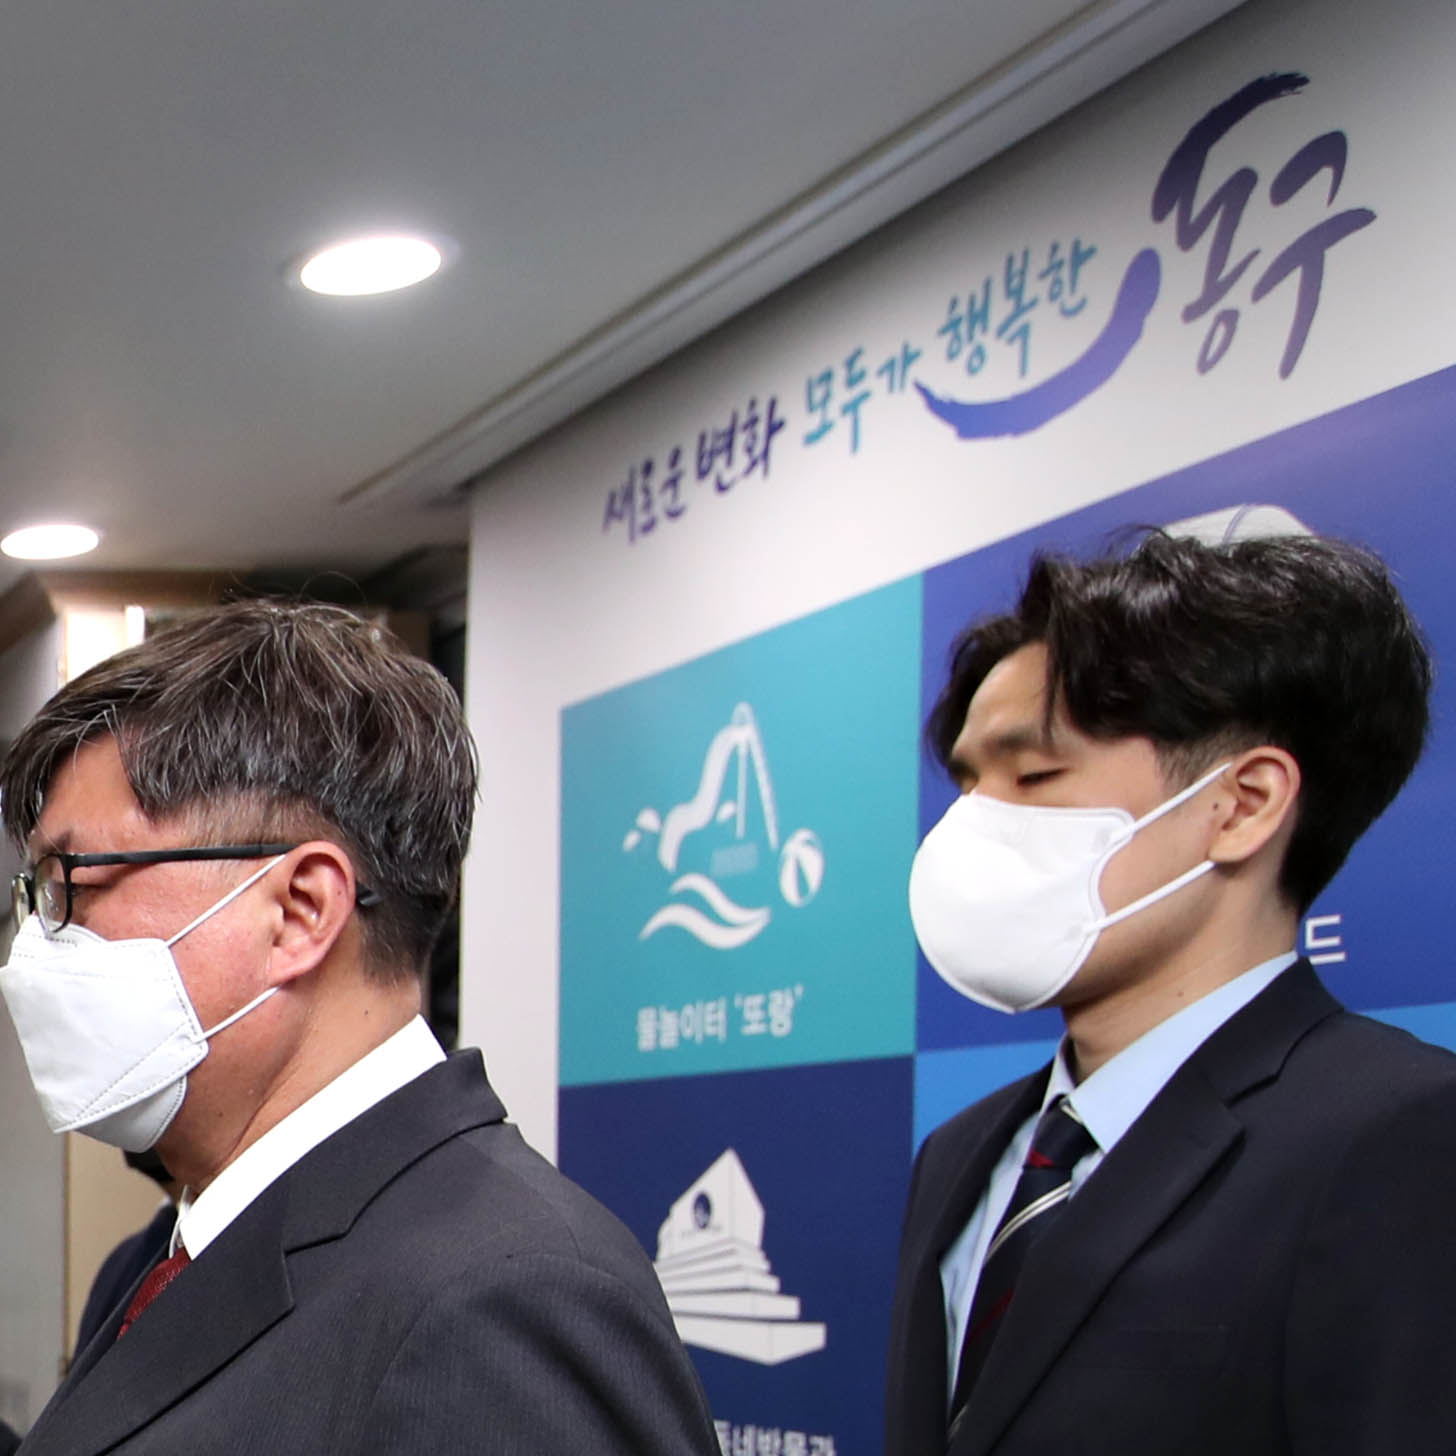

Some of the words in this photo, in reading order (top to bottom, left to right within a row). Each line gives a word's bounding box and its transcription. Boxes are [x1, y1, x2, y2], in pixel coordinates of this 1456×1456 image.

[602, 445, 685, 544] 새로운
[695, 396, 785, 494] 변화
[801, 342, 923, 455] 모두가
[936, 236, 1098, 379] 행복한
[1151, 71, 1378, 381] 동구
[637, 996, 727, 1052] 물놀이터
